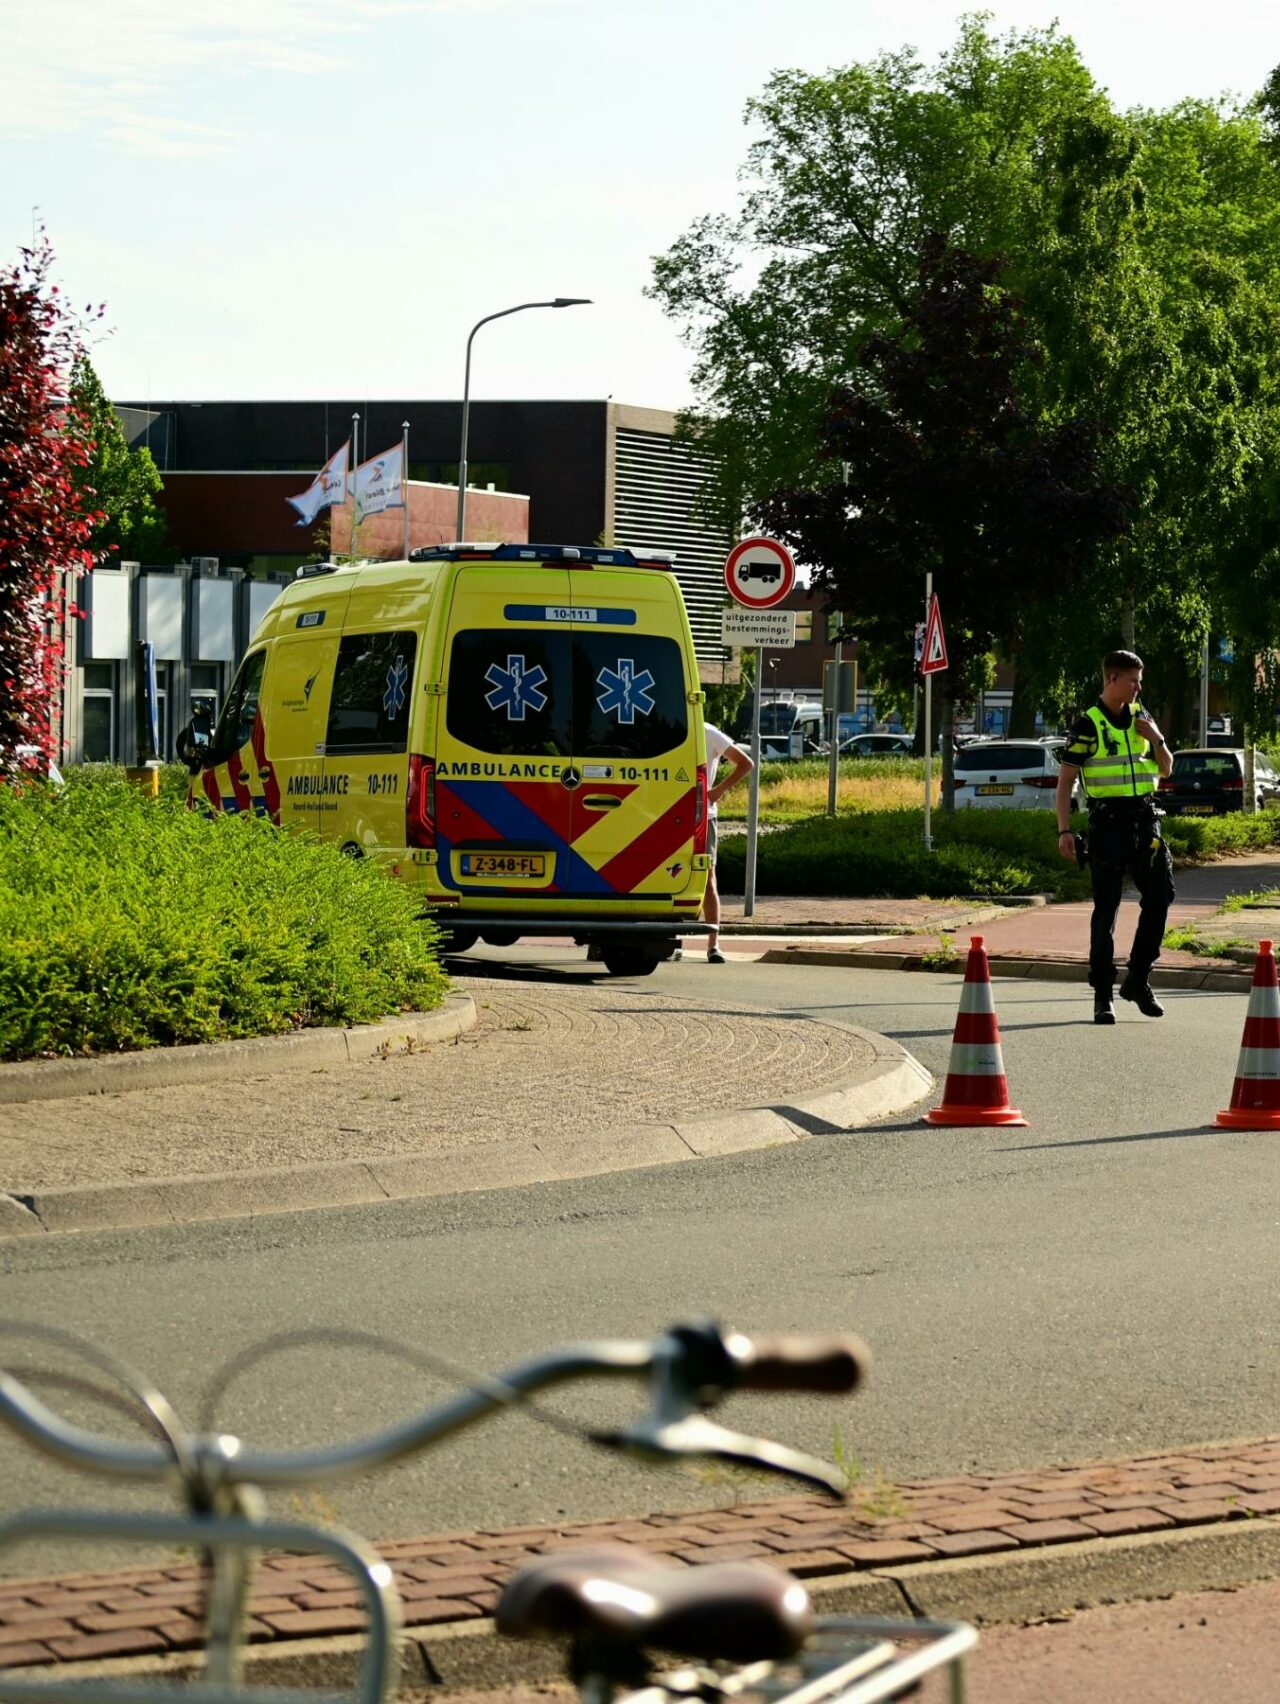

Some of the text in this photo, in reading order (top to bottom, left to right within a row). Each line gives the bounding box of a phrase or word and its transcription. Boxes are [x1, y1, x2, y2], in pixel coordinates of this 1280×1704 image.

[552, 609, 590, 619] 10-111
[726, 614, 787, 623] uitgezonderd
[754, 637, 790, 645] verkeer
[436, 762, 561, 778] AMBULANCE
[619, 767, 668, 781] 10-111
[287, 774, 349, 796] AMBULANCE
[367, 773, 398, 795] 10-111
[475, 857, 537, 872] Z-348-FL
